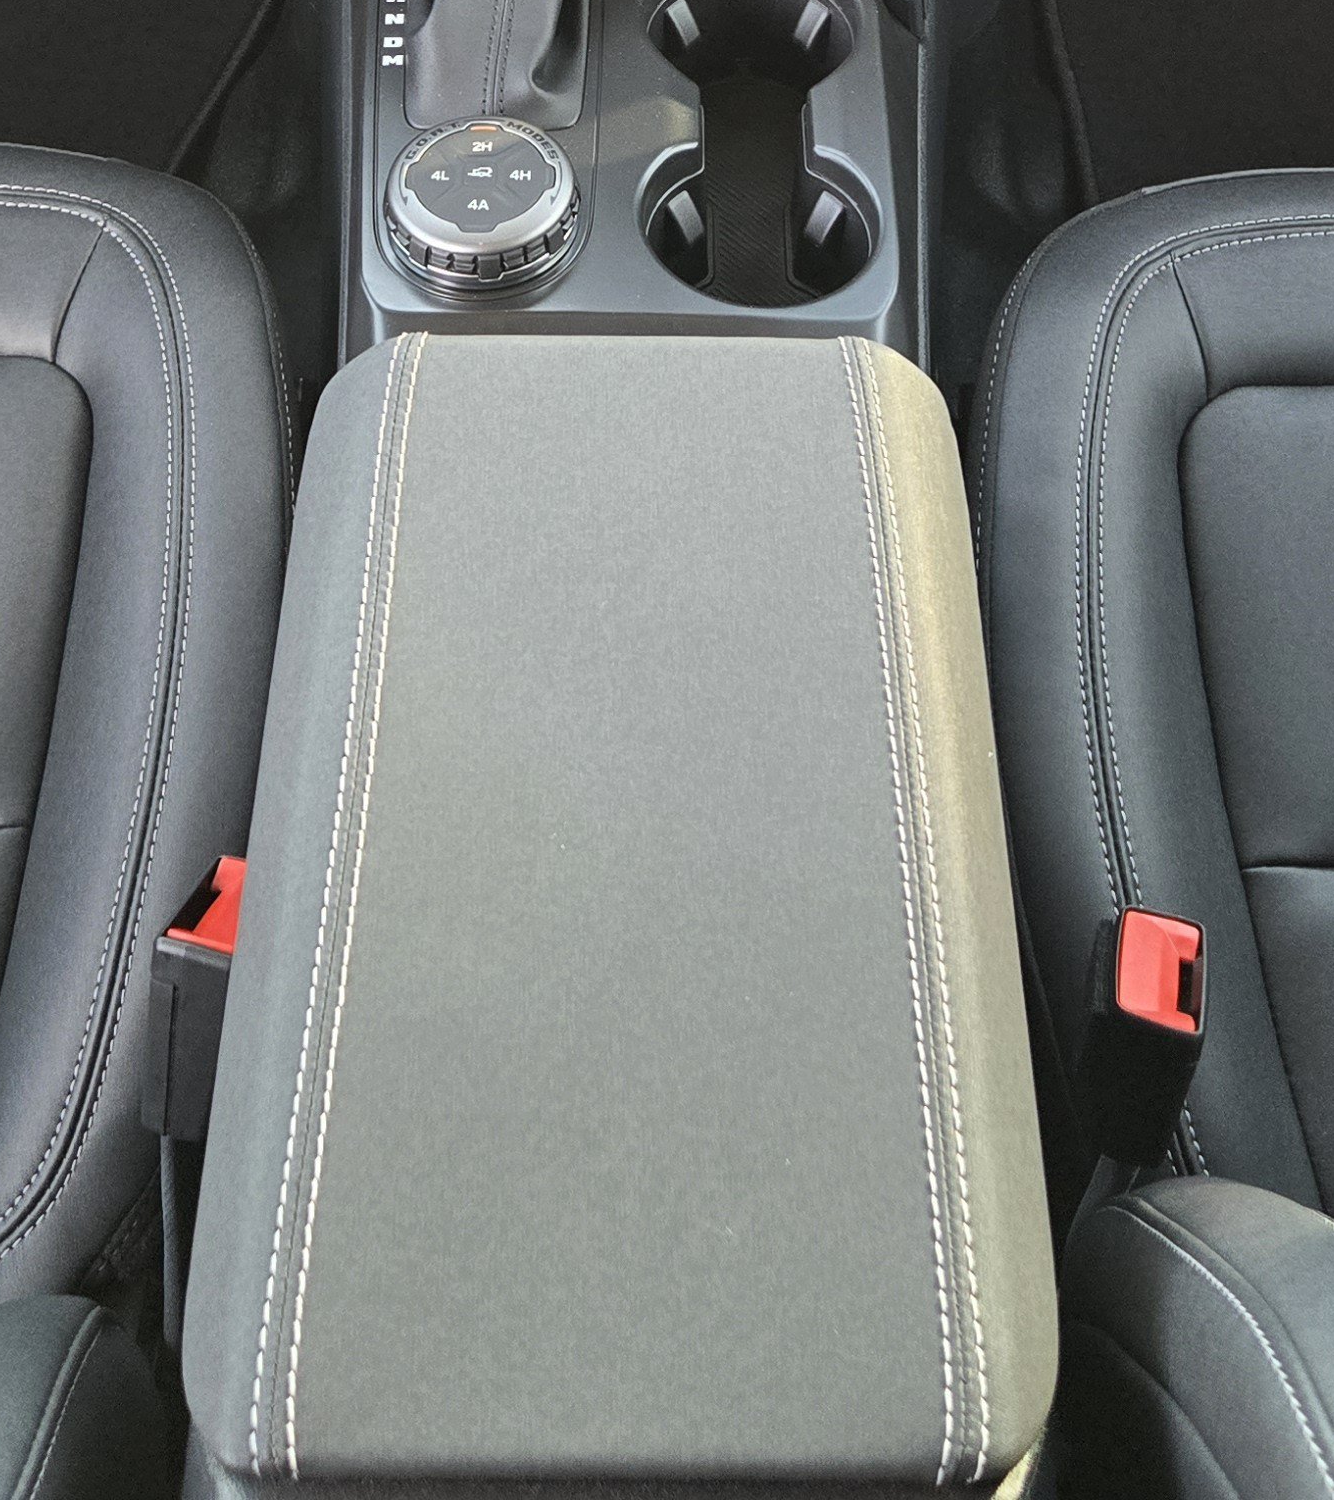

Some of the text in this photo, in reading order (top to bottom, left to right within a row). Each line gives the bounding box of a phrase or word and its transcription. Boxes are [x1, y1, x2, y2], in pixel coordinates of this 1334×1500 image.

[384, 13, 405, 25] N
[383, 36, 403, 48] D
[382, 54, 404, 66] M
[472, 141, 493, 152] 2H
[506, 120, 560, 161] MODES
[430, 170, 532, 181] 4L 4H
[467, 199, 490, 211] 4A
